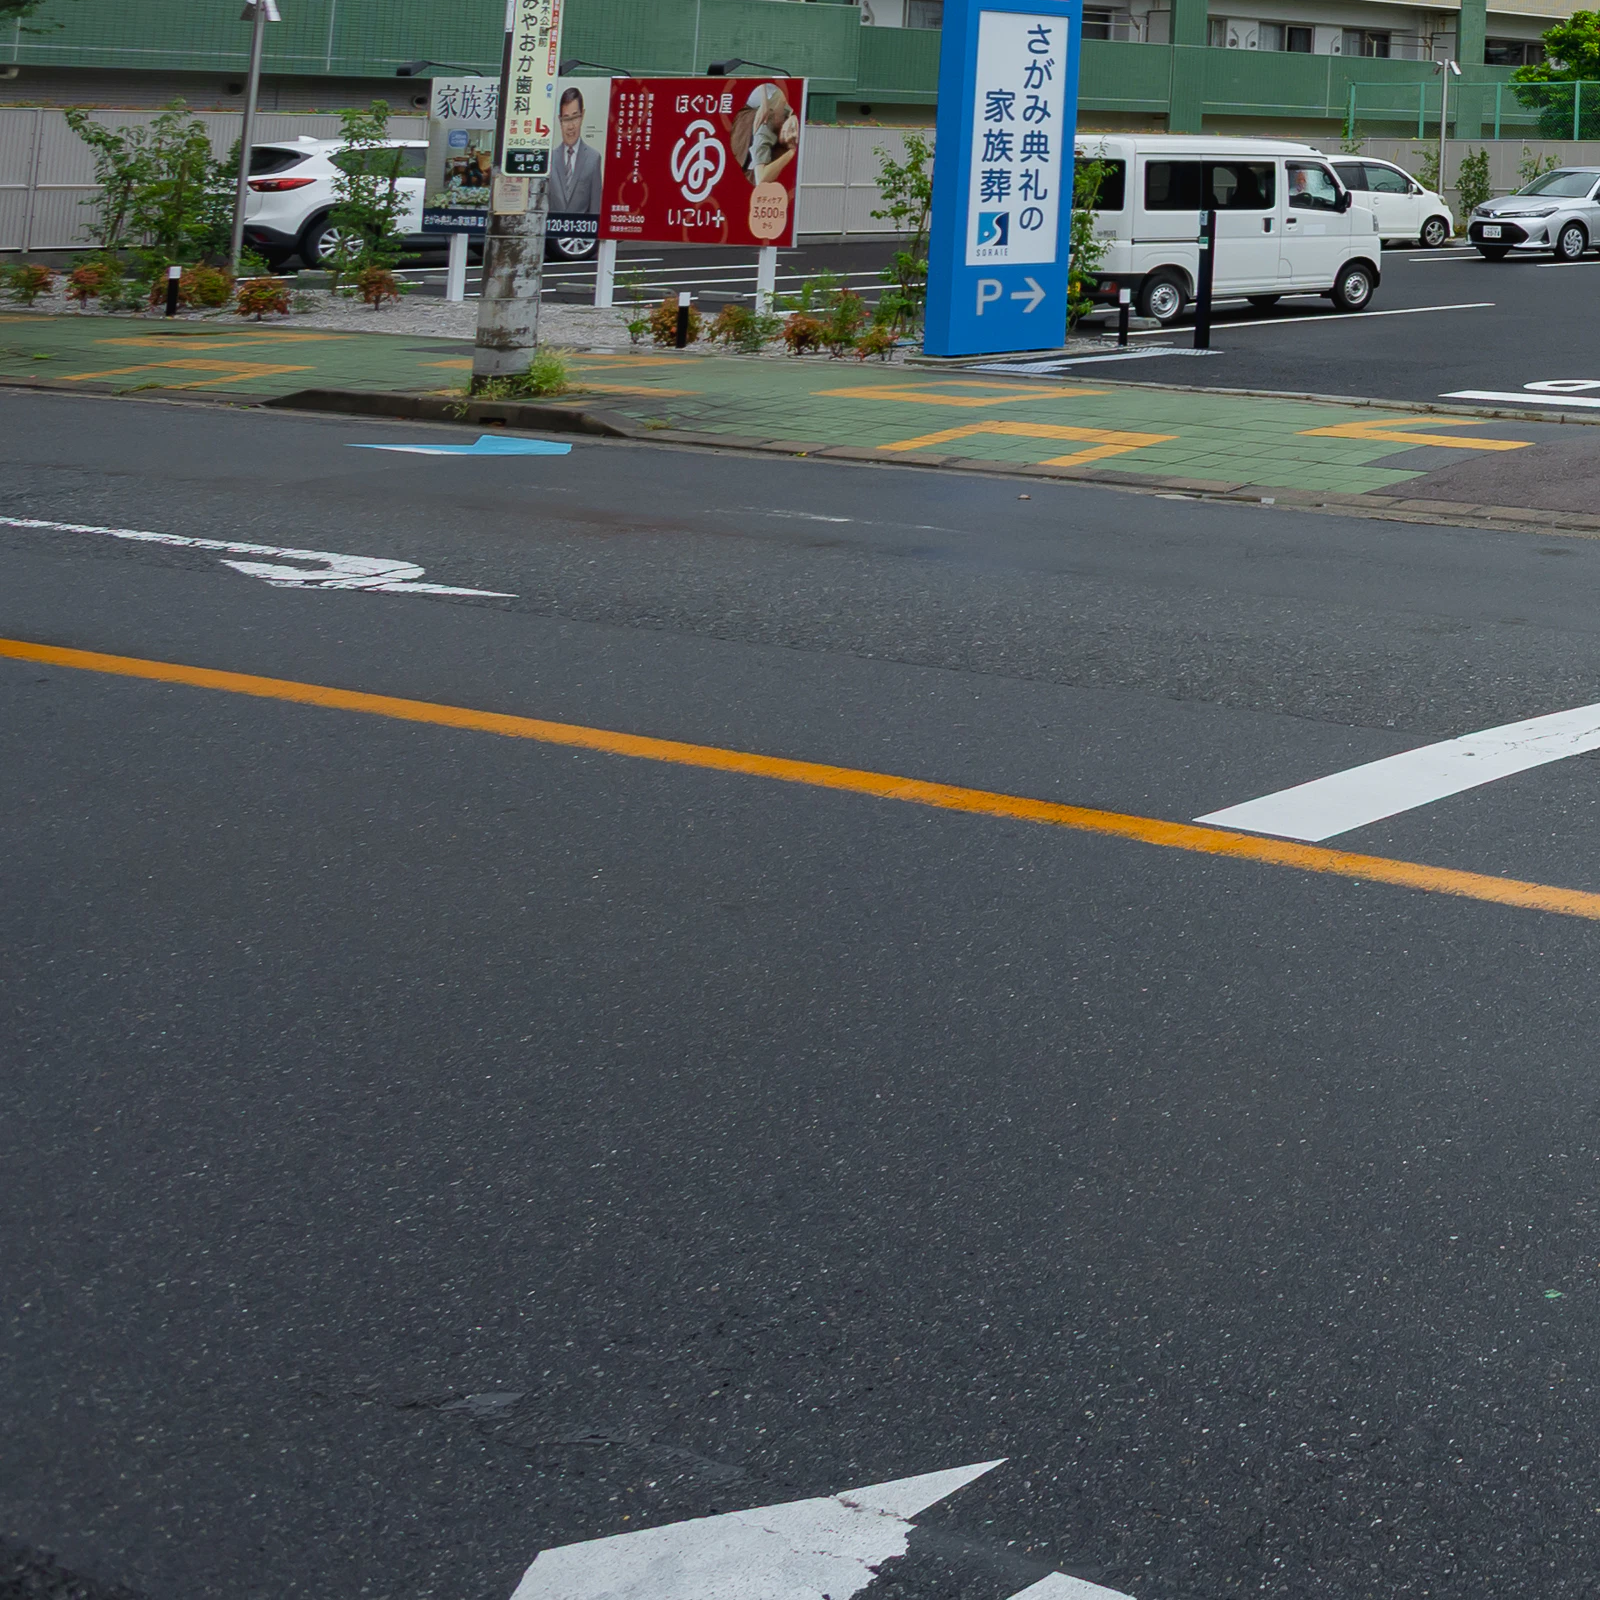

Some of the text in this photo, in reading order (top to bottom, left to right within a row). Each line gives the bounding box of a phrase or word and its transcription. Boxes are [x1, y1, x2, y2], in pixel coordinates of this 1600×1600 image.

[436, 84, 500, 120] 家族葬
[675, 93, 733, 114] ほぐし屋
[1018, 23, 1055, 232] さがみ典礼の
[980, 88, 1016, 204] 家族葬
[753, 206, 785, 219] 3,600円
[976, 248, 1008, 257] SORAIE
[976, 278, 1003, 316] P
